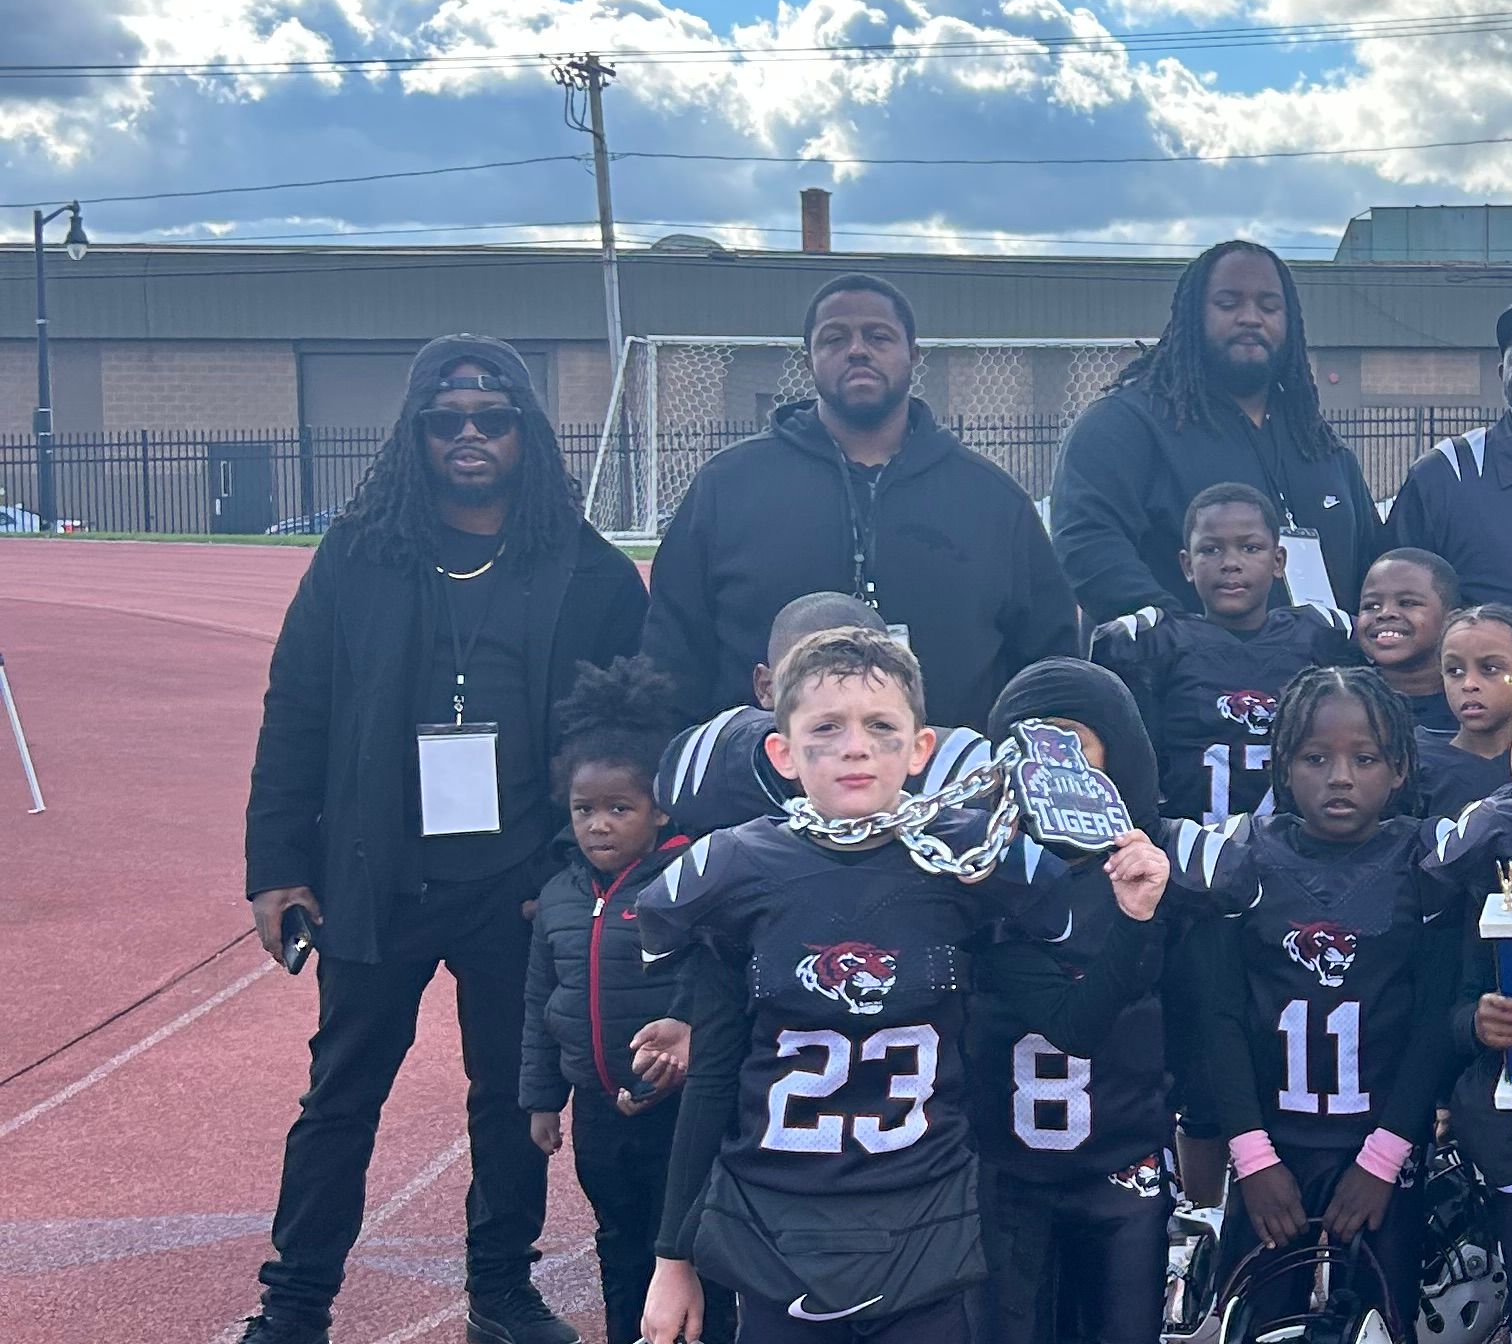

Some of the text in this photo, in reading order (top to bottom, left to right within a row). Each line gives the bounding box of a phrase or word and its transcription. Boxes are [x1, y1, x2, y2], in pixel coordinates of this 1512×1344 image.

[1030, 796, 1129, 837] TIGERS
[760, 1023, 941, 1154] 23
[1012, 1032, 1092, 1151] 8
[1277, 999, 1371, 1115] 11
